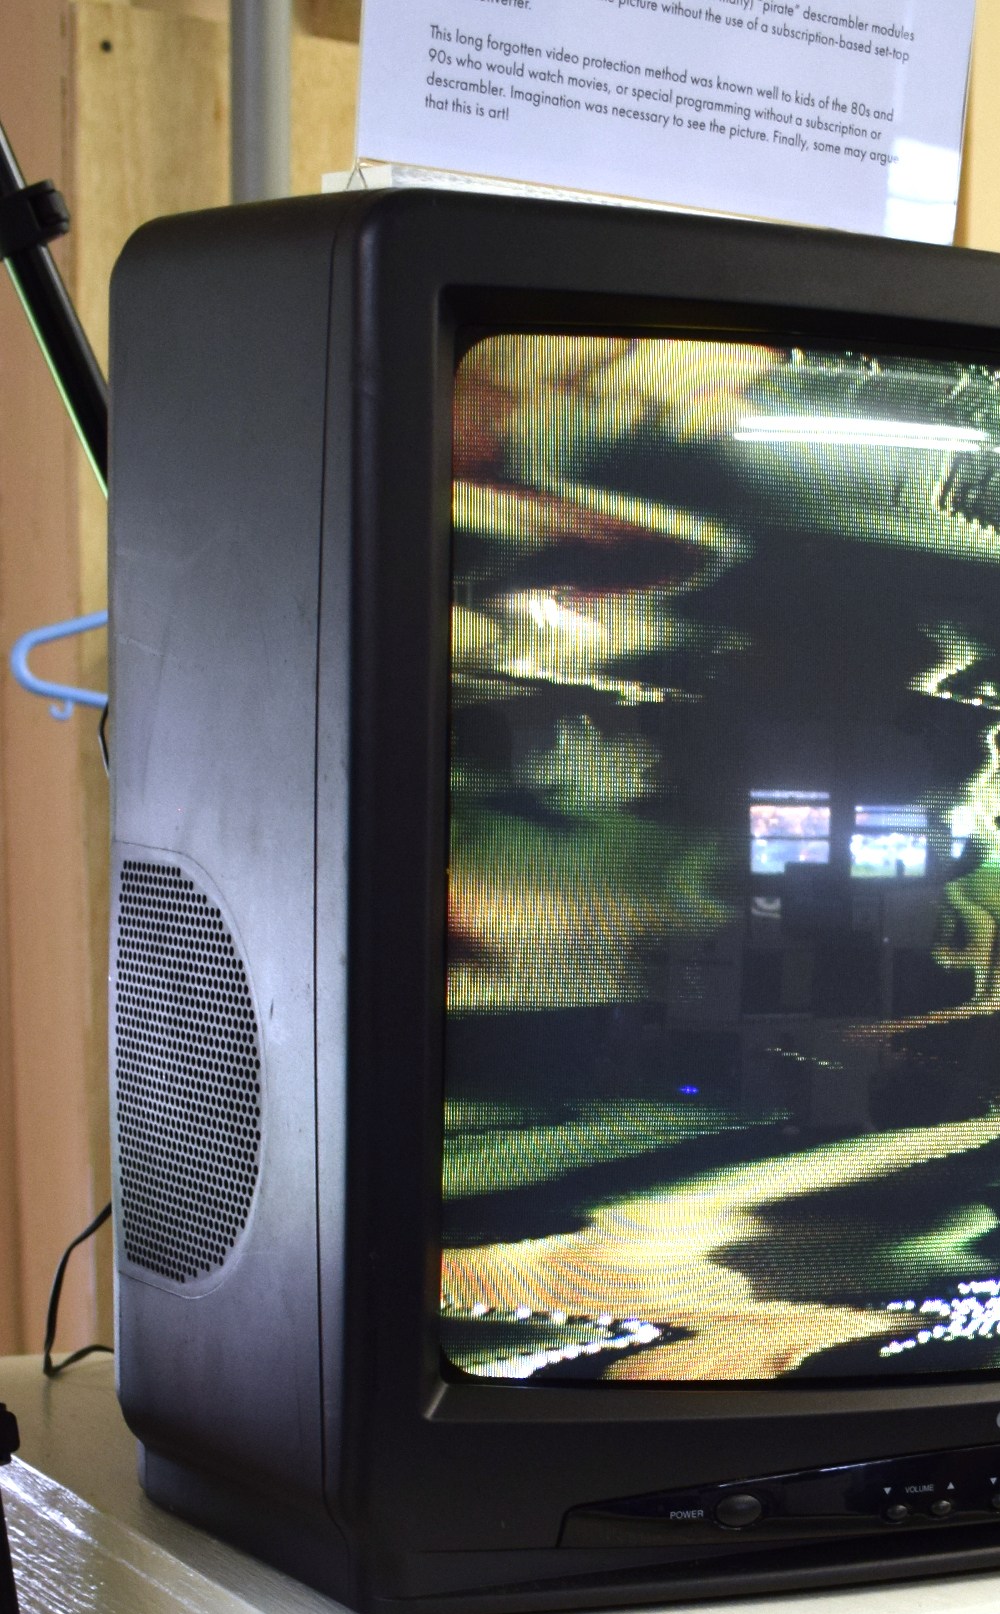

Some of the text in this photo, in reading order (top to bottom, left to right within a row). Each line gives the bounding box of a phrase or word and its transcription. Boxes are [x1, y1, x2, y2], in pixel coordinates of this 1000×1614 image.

[661, 3, 702, 20] without
[705, 9, 722, 24] the
[725, 16, 744, 28] use
[746, 18, 759, 31] of
[760, 23, 768, 34] a
[771, 23, 872, 54] subscription-based
[874, 45, 910, 65] set-top
[803, 6, 869, 31] descrambler
[871, 24, 915, 41] modules
[428, 48, 883, 141] 90s who would watch movies, or special programming without a subscription or
[430, 24, 894, 122] This long forgotten video protection method was known well to kids of the 80s and
[425, 93, 510, 121] that this is art!
[426, 71, 506, 98] descrambler.
[510, 85, 581, 109] Imagination
[584, 102, 608, 115] was
[611, 104, 670, 128] necessary
[672, 115, 684, 128] to
[687, 118, 706, 131] see
[709, 118, 726, 134] the
[729, 125, 770, 142] picture.
[772, 130, 809, 152] Finally,
[813, 140, 841, 155] some
[844, 146, 867, 162] may
[905, 1484, 934, 1494] VOLUME
[669, 1510, 704, 1520] POWER
